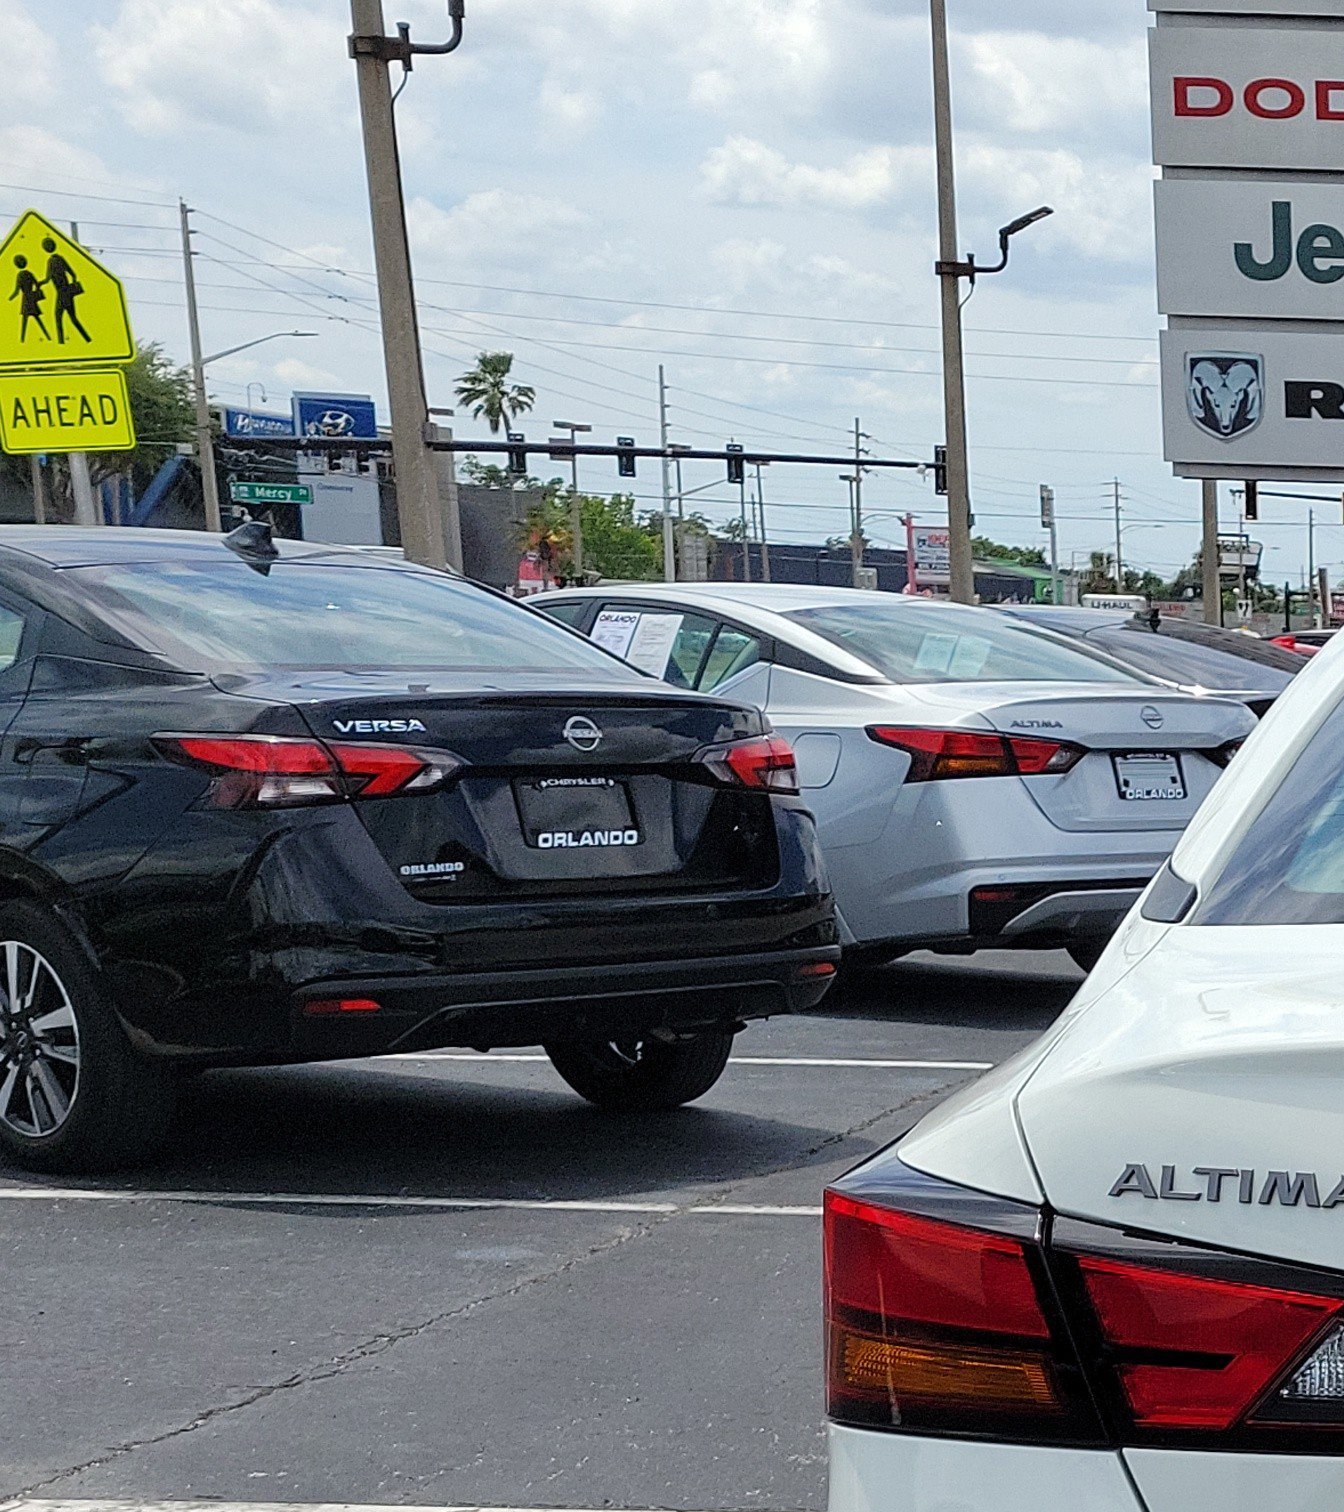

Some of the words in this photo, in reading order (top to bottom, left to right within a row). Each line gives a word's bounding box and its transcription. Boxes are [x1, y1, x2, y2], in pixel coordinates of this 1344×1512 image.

[12, 393, 118, 429] AHEAD
[254, 486, 292, 501] Mercy
[333, 719, 427, 733] VERSA
[1010, 720, 1063, 729] ALTIMA
[546, 777, 606, 786] CHRYSLER
[1126, 788, 1184, 800] ORLANDO
[537, 829, 639, 849] ORLANDO
[400, 861, 465, 876] ORLANDO
